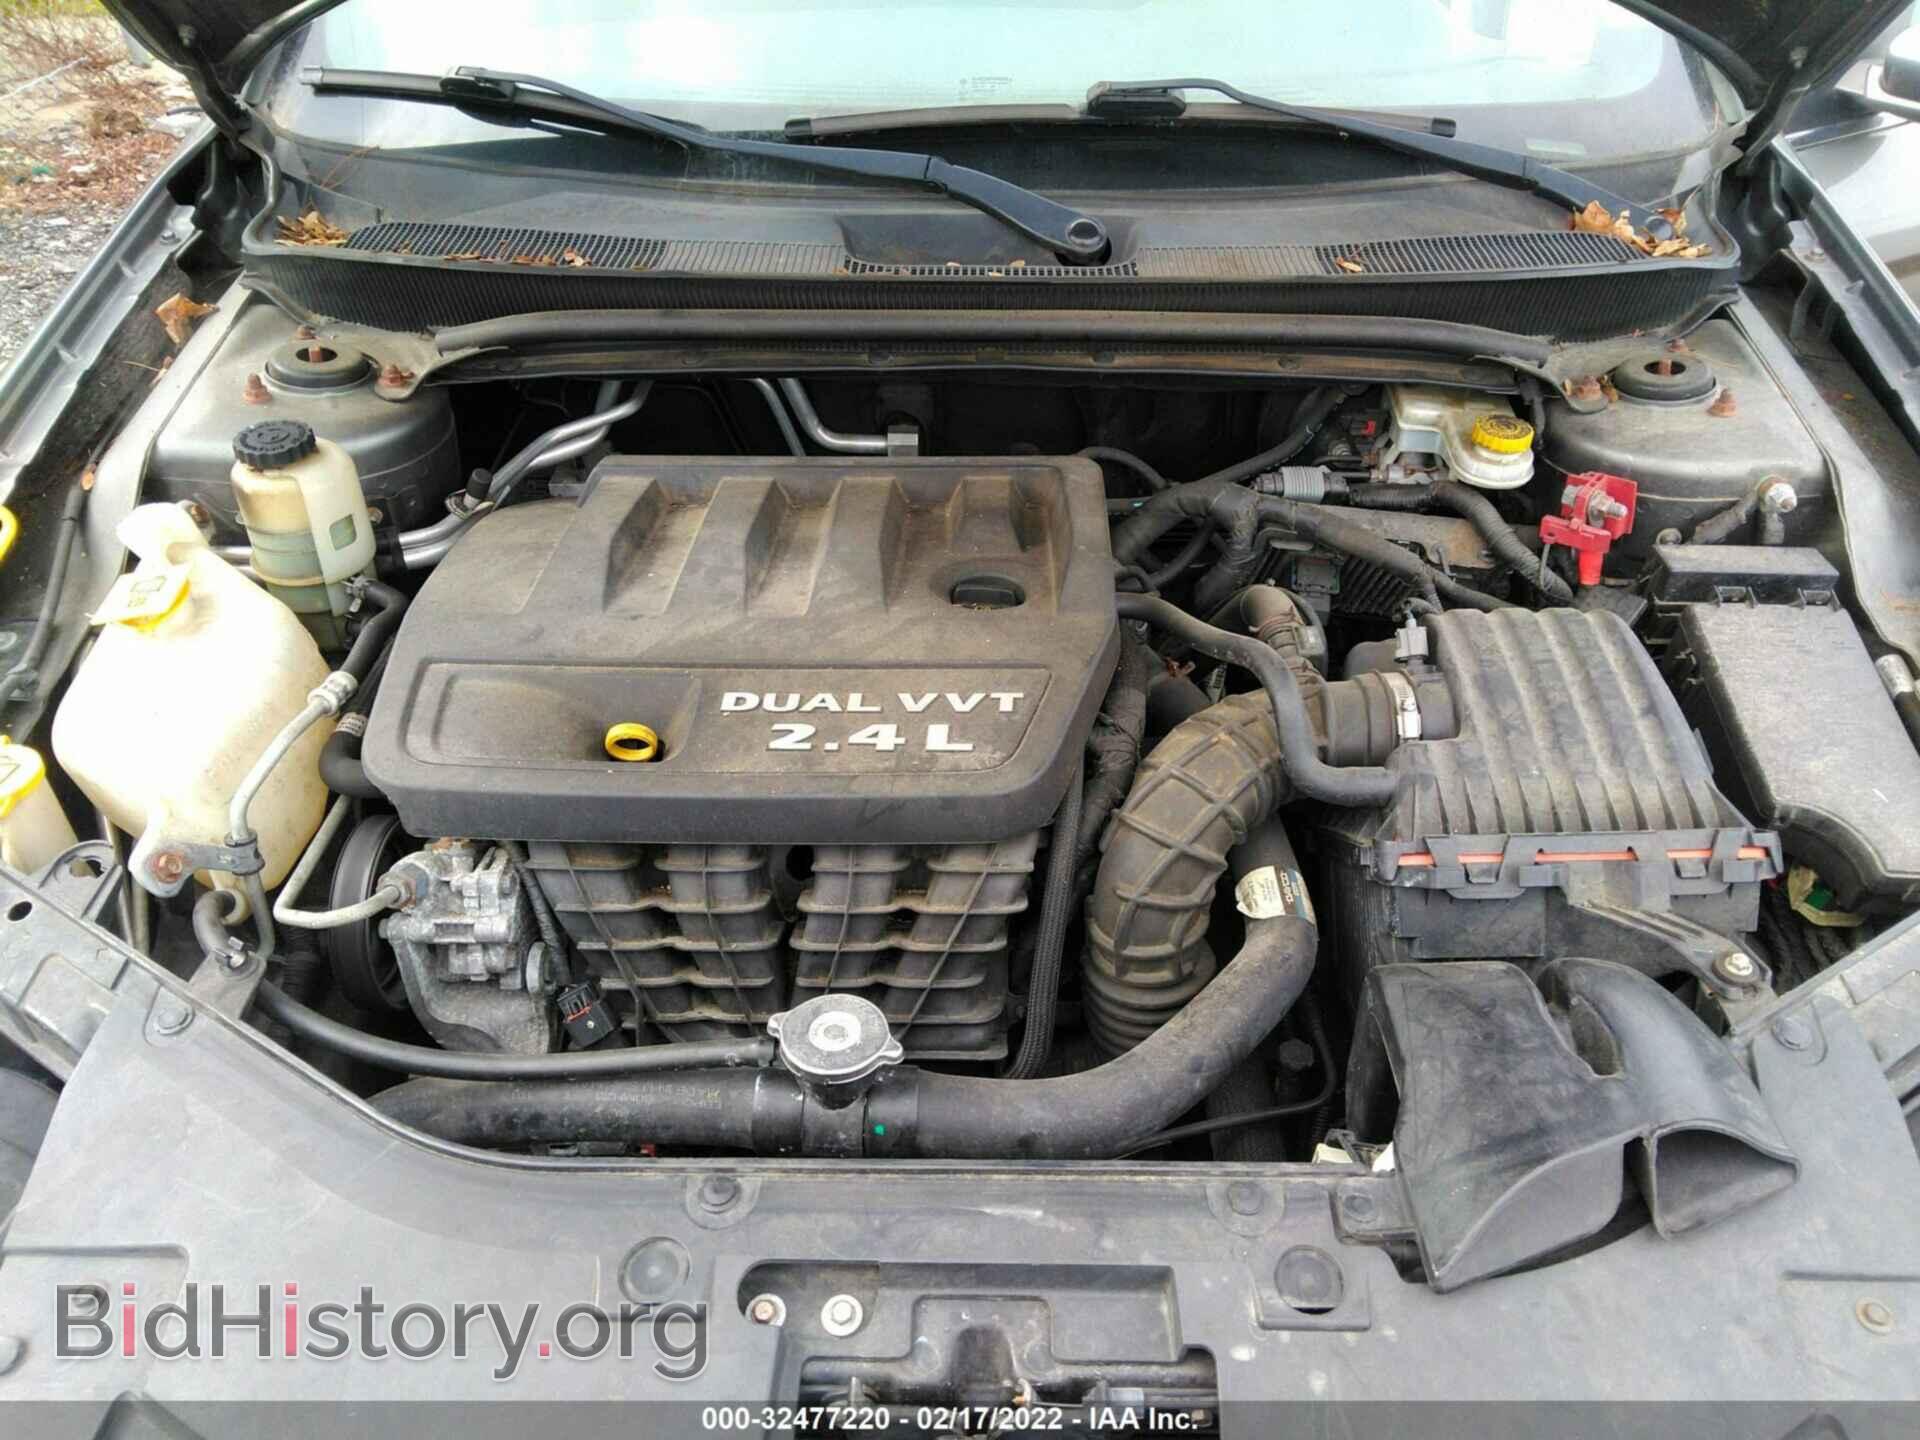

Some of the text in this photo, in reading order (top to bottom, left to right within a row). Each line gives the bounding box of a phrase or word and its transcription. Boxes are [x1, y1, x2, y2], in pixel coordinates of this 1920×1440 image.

[719, 691, 1025, 713] DUAL VVT
[766, 723, 975, 751] 2.4 L
